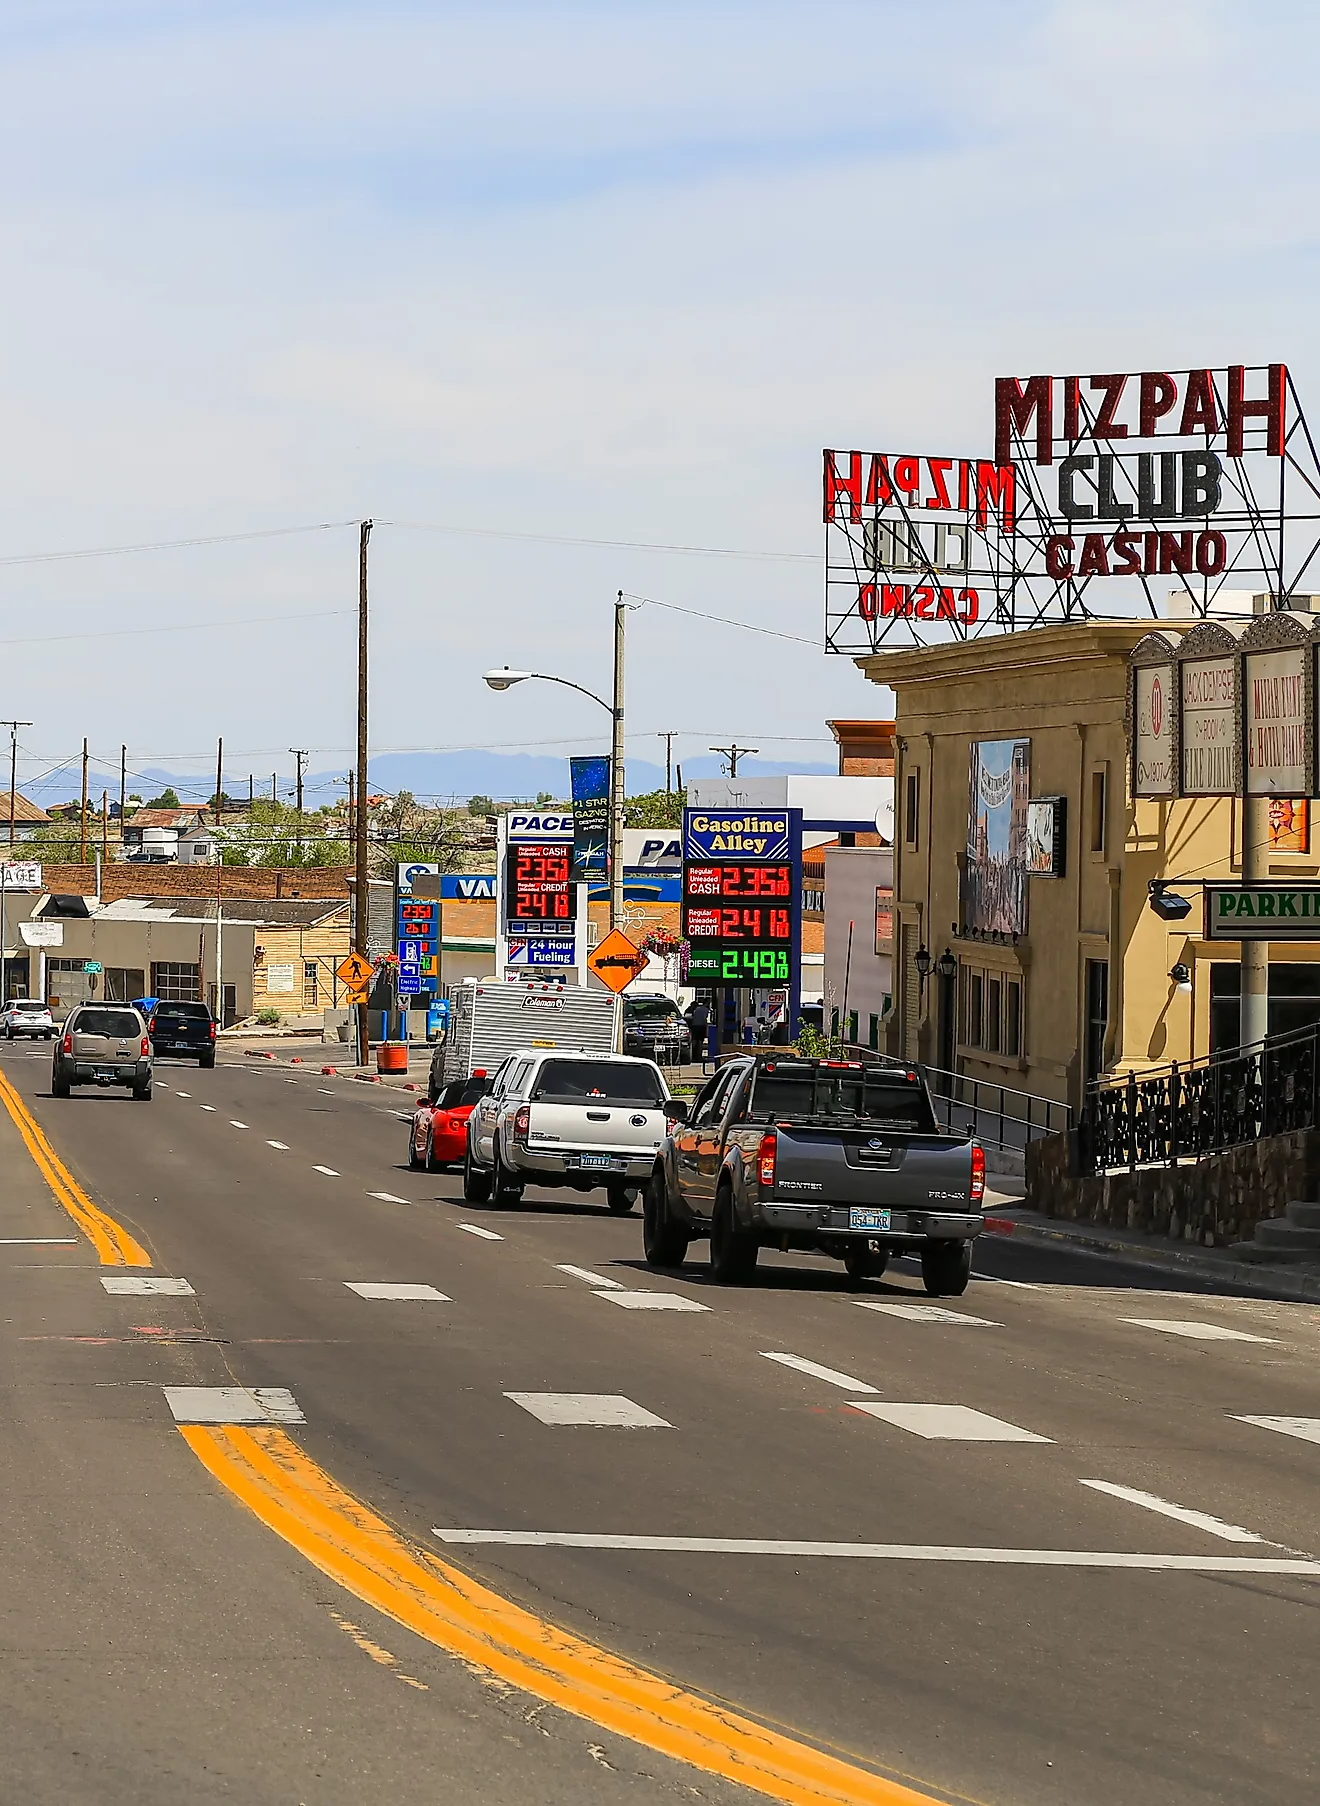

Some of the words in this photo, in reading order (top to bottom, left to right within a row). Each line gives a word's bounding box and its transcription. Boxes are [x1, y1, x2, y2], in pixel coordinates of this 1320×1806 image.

[995, 364, 1286, 466] MIZPAH
[1058, 450, 1223, 520] CLUB
[1046, 530, 1226, 580] CASINO
[692, 817, 785, 833] Gasoline
[709, 834, 767, 854] Alley
[543, 847, 567, 856] CASH
[689, 868, 714, 876] Regular
[690, 875, 719, 883] Unleaded
[541, 882, 567, 892] CREDIT
[689, 883, 721, 894] CASH
[688, 909, 713, 917] Regular
[688, 925, 719, 936] CREDIT
[530, 940, 545, 949] 24
[548, 940, 573, 949] Hour
[533, 953, 571, 963] Fueling
[688, 959, 719, 968] DIESEL
[524, 996, 555, 1007] Coleman
[778, 1180, 823, 1191] FRONTIER
